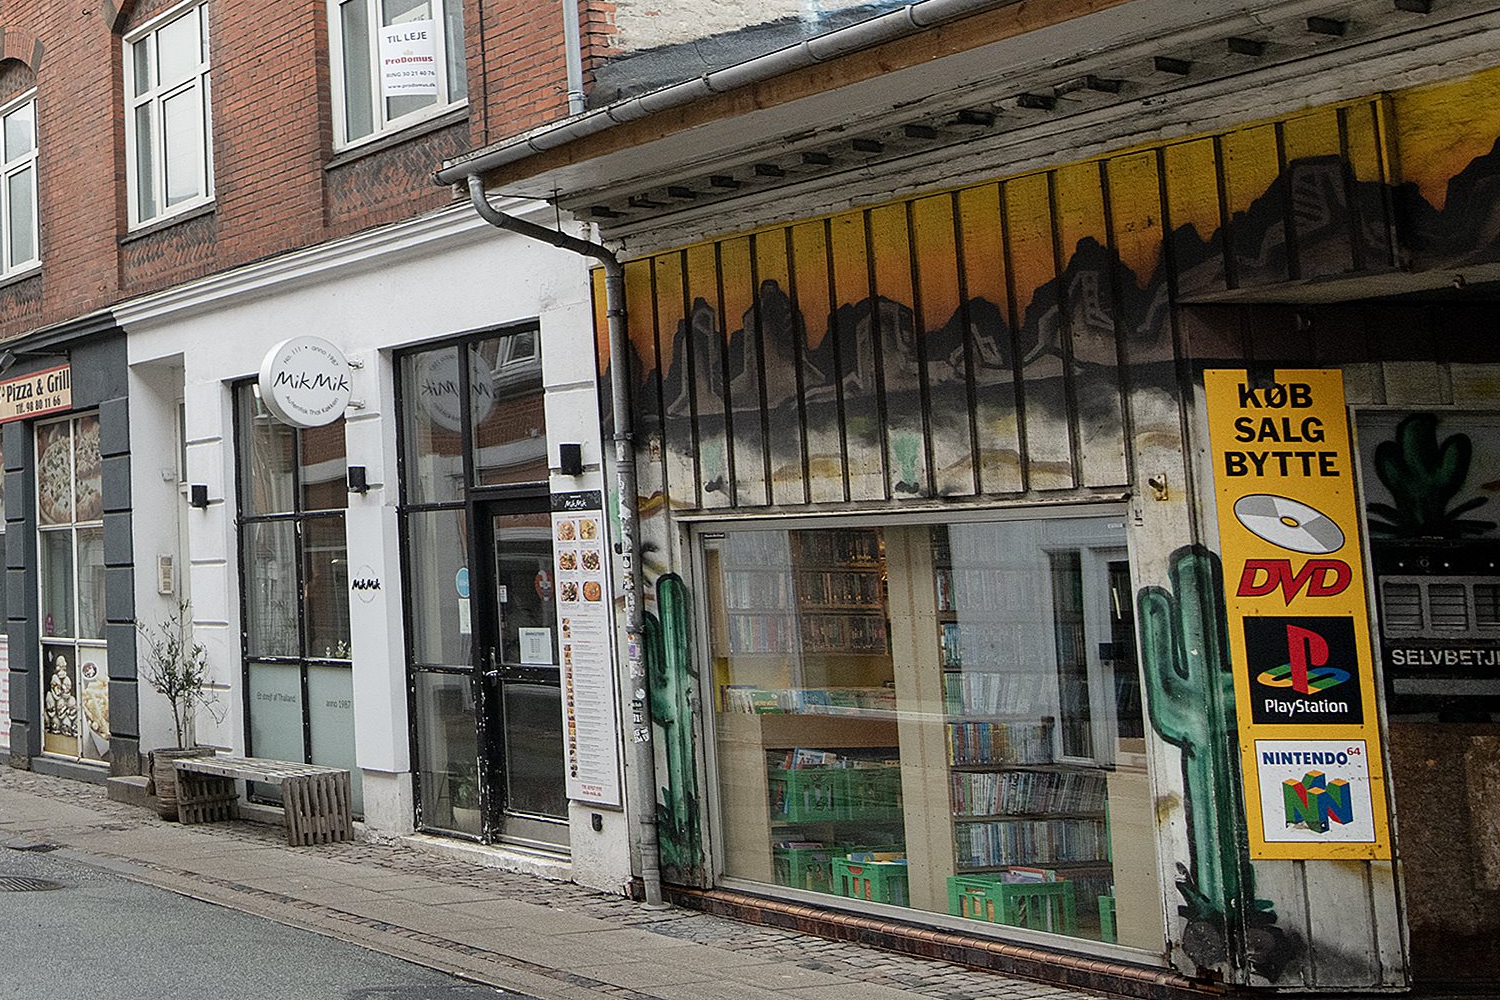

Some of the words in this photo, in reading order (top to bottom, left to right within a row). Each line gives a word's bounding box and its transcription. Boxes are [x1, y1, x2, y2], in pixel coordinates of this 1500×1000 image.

[386, 34, 402, 43] TIL
[404, 31, 427, 41] LEJE
[7, 382, 33, 403] Pizza
[36, 378, 44, 396] &
[47, 369, 70, 393] Grill
[1237, 383, 1313, 408] KØB
[26, 402, 34, 412] 98
[45, 398, 51, 409] 11
[1234, 417, 1325, 443] SALG
[1224, 451, 1340, 477] BYTTE
[1236, 559, 1352, 607] DVD
[1264, 699, 1348, 717] PlayStation
[1262, 751, 1348, 766] NINTENDO
[1347, 747, 1361, 756] 64
